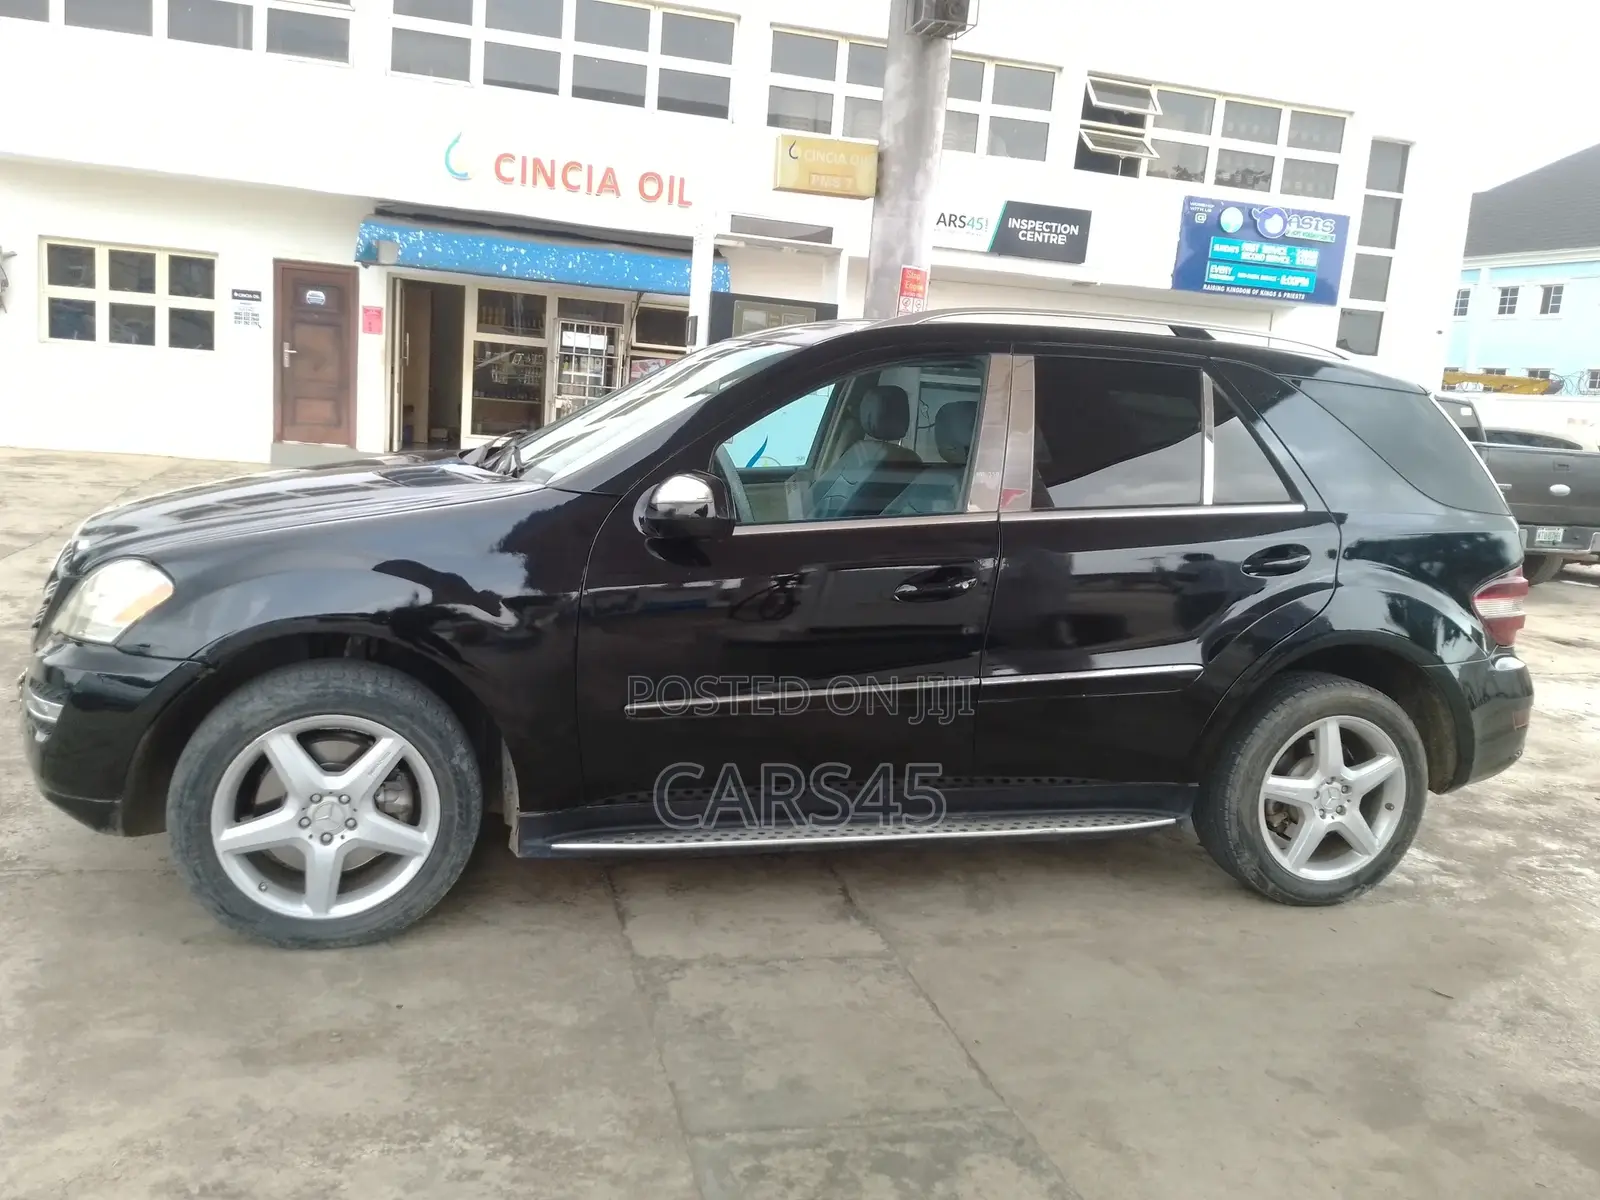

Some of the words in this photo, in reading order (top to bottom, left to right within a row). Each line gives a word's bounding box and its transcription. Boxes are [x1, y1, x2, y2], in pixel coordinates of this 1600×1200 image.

[494, 152, 621, 198] CINCIA
[638, 171, 693, 208] OIL
[936, 212, 984, 231] ARS45
[1008, 217, 1079, 236] INSPECTION
[1018, 230, 1066, 245] CENTRE
[1203, 284, 1225, 292] RAISING
[1226, 285, 1251, 295] KINGDOM
[1260, 289, 1277, 298] KINGS
[1283, 291, 1305, 300] PRIESTS
